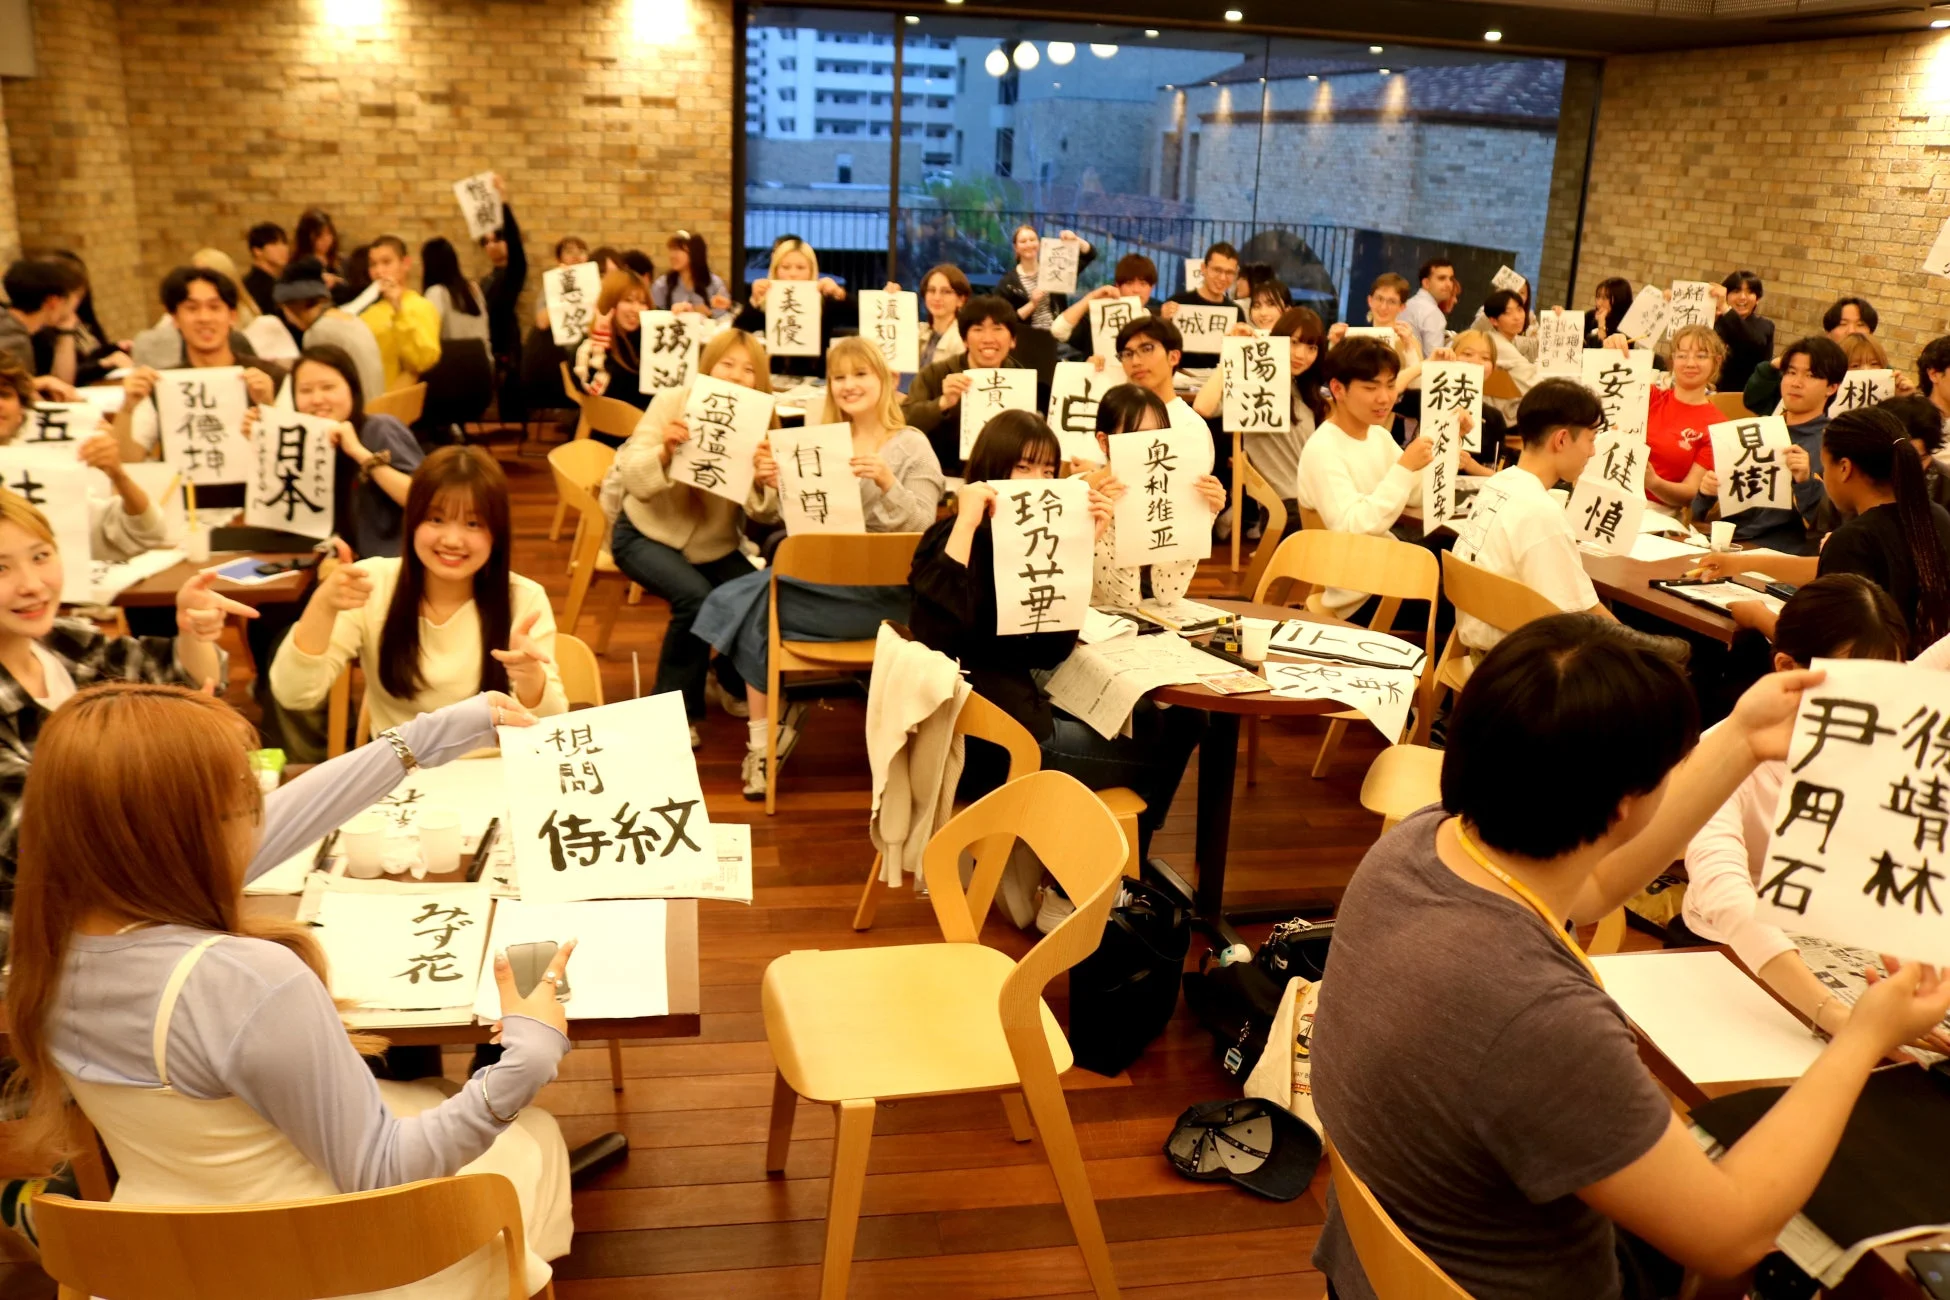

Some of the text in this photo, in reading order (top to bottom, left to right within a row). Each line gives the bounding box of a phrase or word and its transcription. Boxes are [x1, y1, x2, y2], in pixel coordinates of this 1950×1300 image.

[772, 286, 805, 347] 美優
[1178, 311, 1229, 335] 城田
[1239, 341, 1283, 428] 陽流
[25, 408, 76, 443] 五
[1728, 422, 1781, 502] 見樹
[264, 424, 325, 521] 日本
[1010, 488, 1067, 632] 玲乃華
[391, 903, 474, 984] みず花
